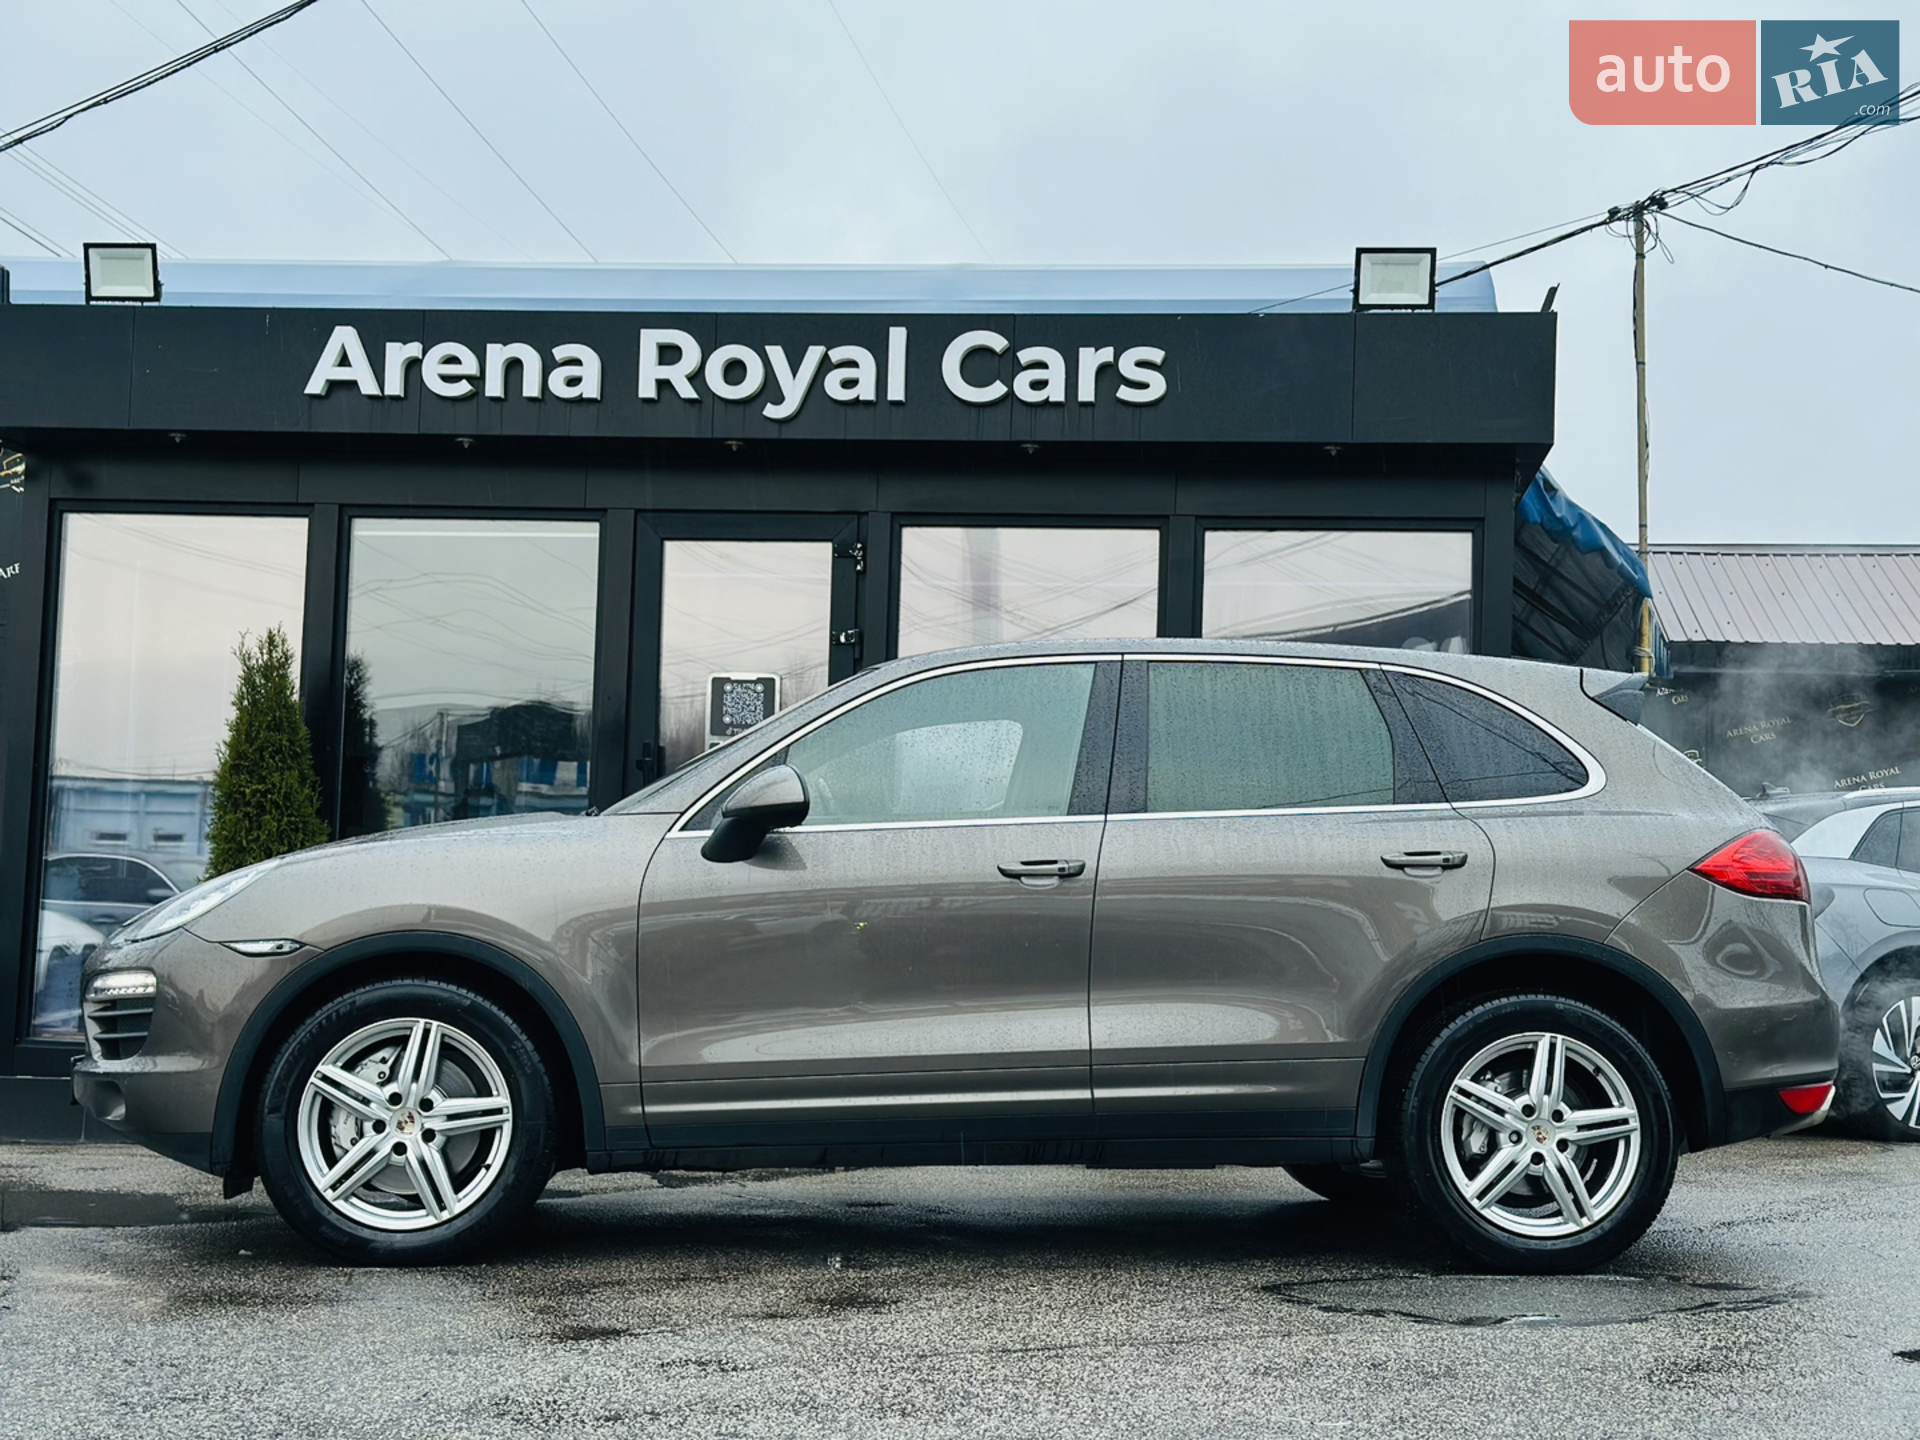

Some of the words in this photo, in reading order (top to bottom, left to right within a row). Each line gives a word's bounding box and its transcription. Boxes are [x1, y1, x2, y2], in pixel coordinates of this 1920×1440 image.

[303, 325, 602, 401] Arena
[637, 326, 908, 421] Royal
[941, 329, 1168, 405] Cars
[1726, 724, 1759, 738] ARENA
[1760, 715, 1792, 729] ROYAL
[1750, 732, 1776, 744] CARS
[1834, 774, 1868, 789] ARENA
[1868, 766, 1901, 781] ROYAL
